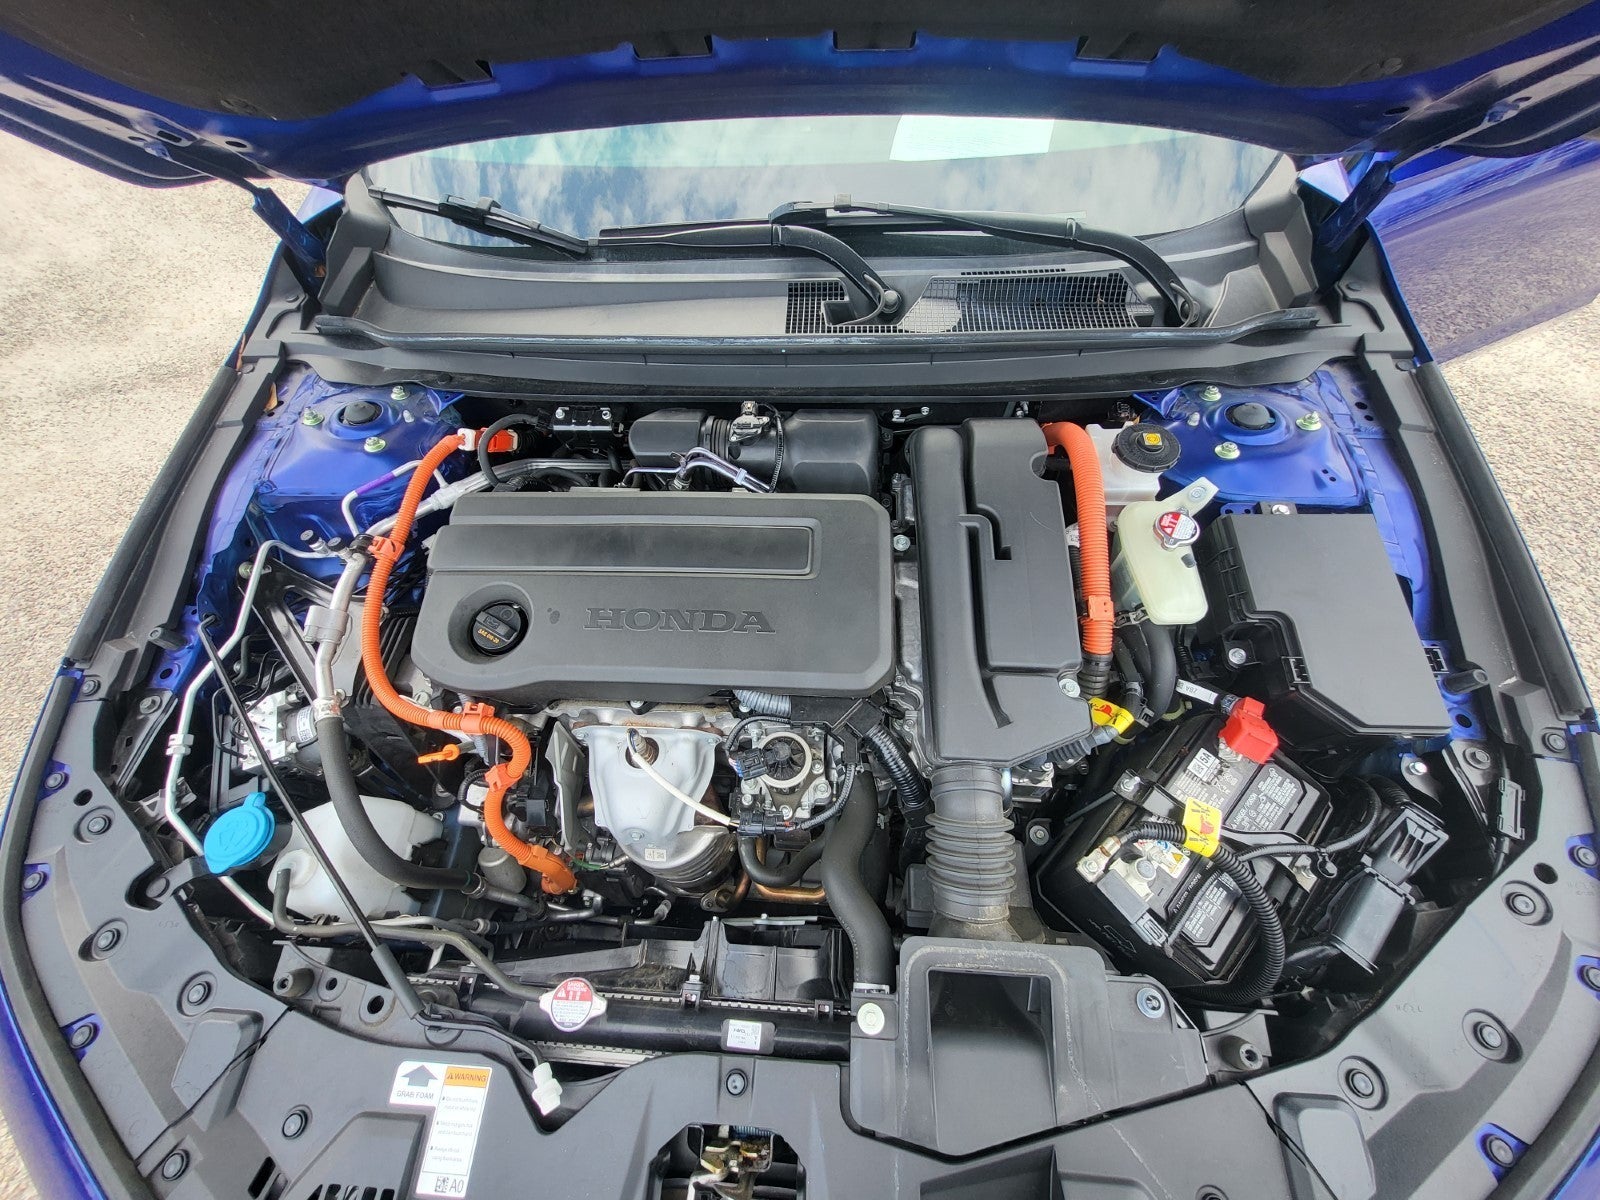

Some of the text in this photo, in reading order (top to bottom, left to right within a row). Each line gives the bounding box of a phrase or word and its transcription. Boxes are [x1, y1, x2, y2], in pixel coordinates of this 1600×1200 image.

[583, 607, 776, 634] HONDA
[453, 1072, 487, 1083] WARNING
[396, 1090, 434, 1100] GRAB FOAM
